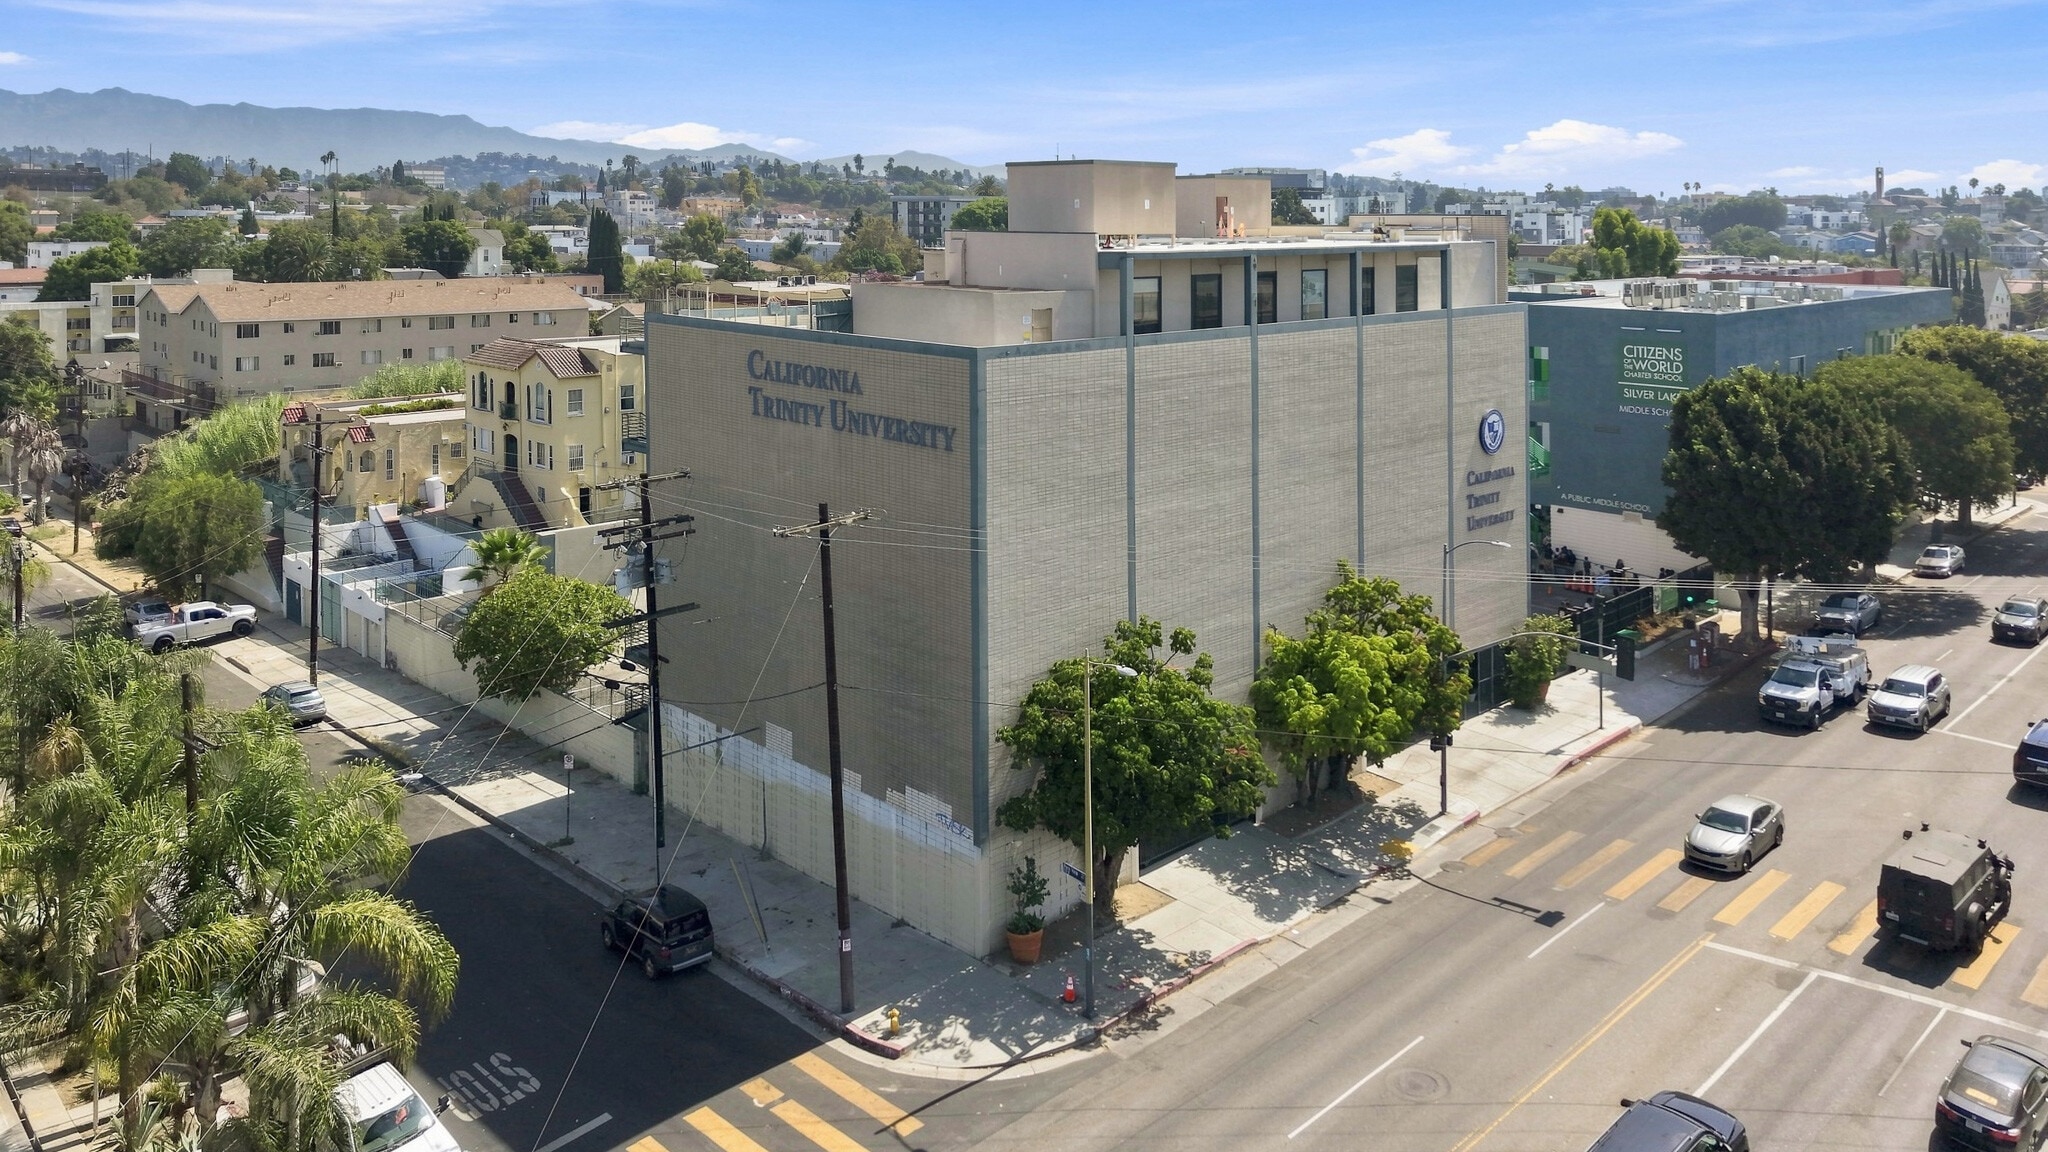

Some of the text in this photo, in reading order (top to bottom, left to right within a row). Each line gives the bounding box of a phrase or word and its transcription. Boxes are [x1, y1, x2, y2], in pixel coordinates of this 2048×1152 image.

[1623, 344, 1683, 361] CITIZENS
[747, 349, 863, 395] CALIFORNIA
[1632, 358, 1683, 374] WORLD
[1623, 370, 1683, 382] CHARTER SCHOOL
[1623, 388, 1655, 400] SILVER
[748, 385, 957, 452] TRINITY UNIVERSITY
[1618, 405, 1650, 415] MIDDLE
[1567, 493, 1592, 504] PUBLIC
[1592, 498, 1619, 509] MIDDLE
[1620, 501, 1652, 513] SCHOOL
[436, 1052, 542, 1122] STOP
